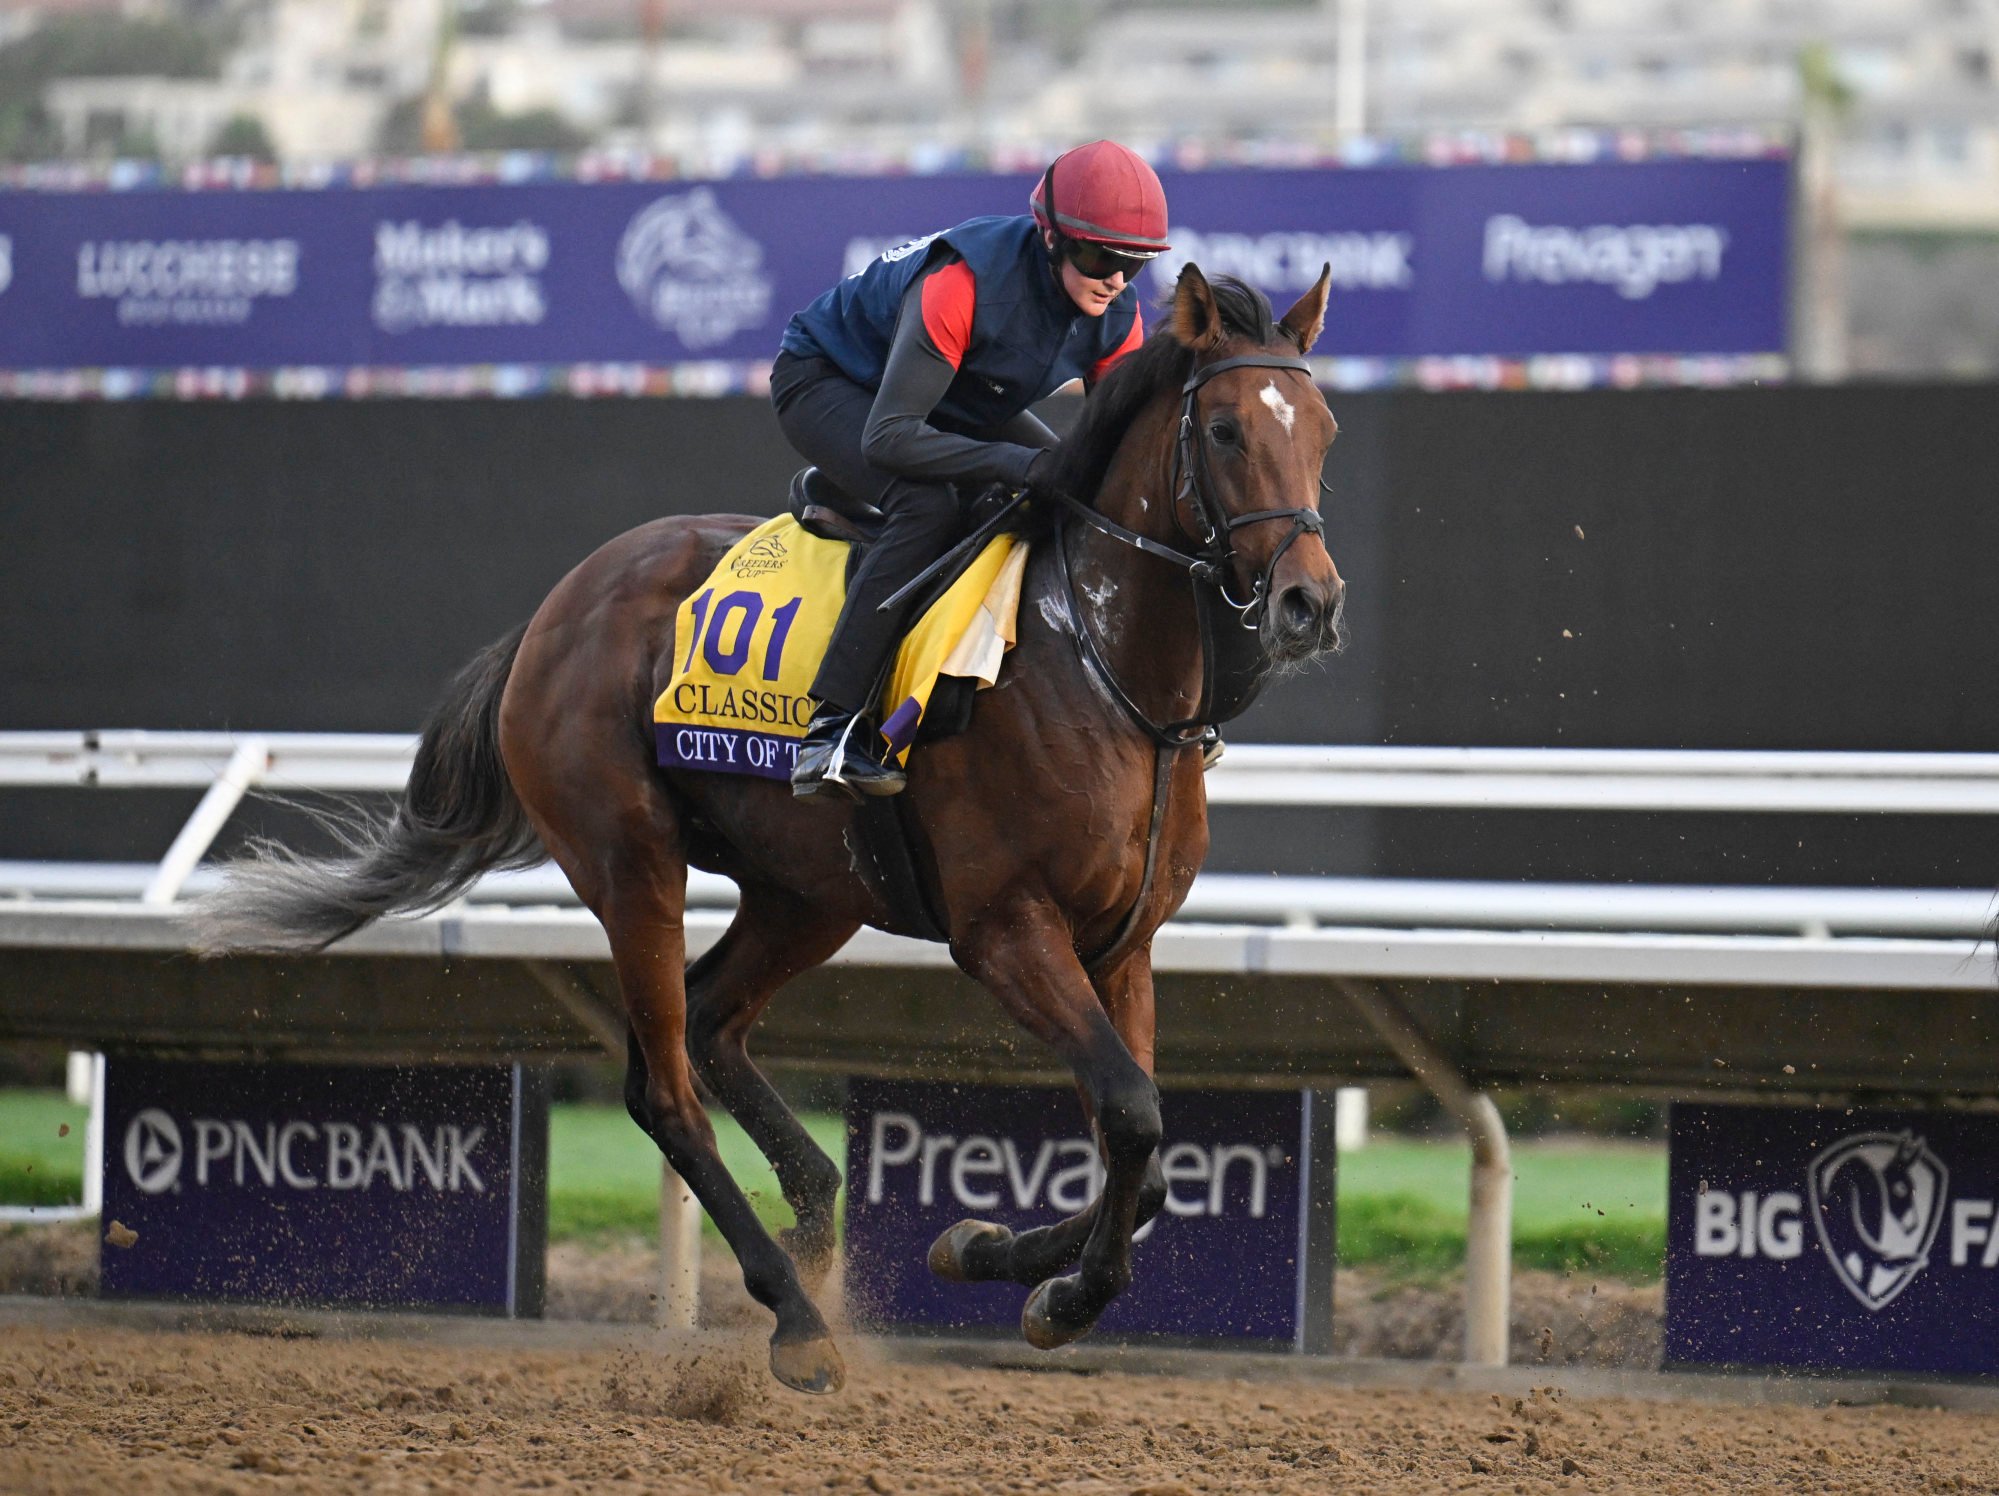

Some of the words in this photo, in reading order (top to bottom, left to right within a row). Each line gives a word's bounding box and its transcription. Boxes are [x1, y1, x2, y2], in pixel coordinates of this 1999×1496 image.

[1483, 213, 1723, 300] Prevagen
[683, 588, 802, 681] 101
[674, 683, 812, 728] CLASSIC
[676, 729, 738, 763] CITY
[746, 736, 779, 768] OF
[867, 1112, 1267, 1243] Prevaen
[1695, 1189, 1804, 1260] BIG
